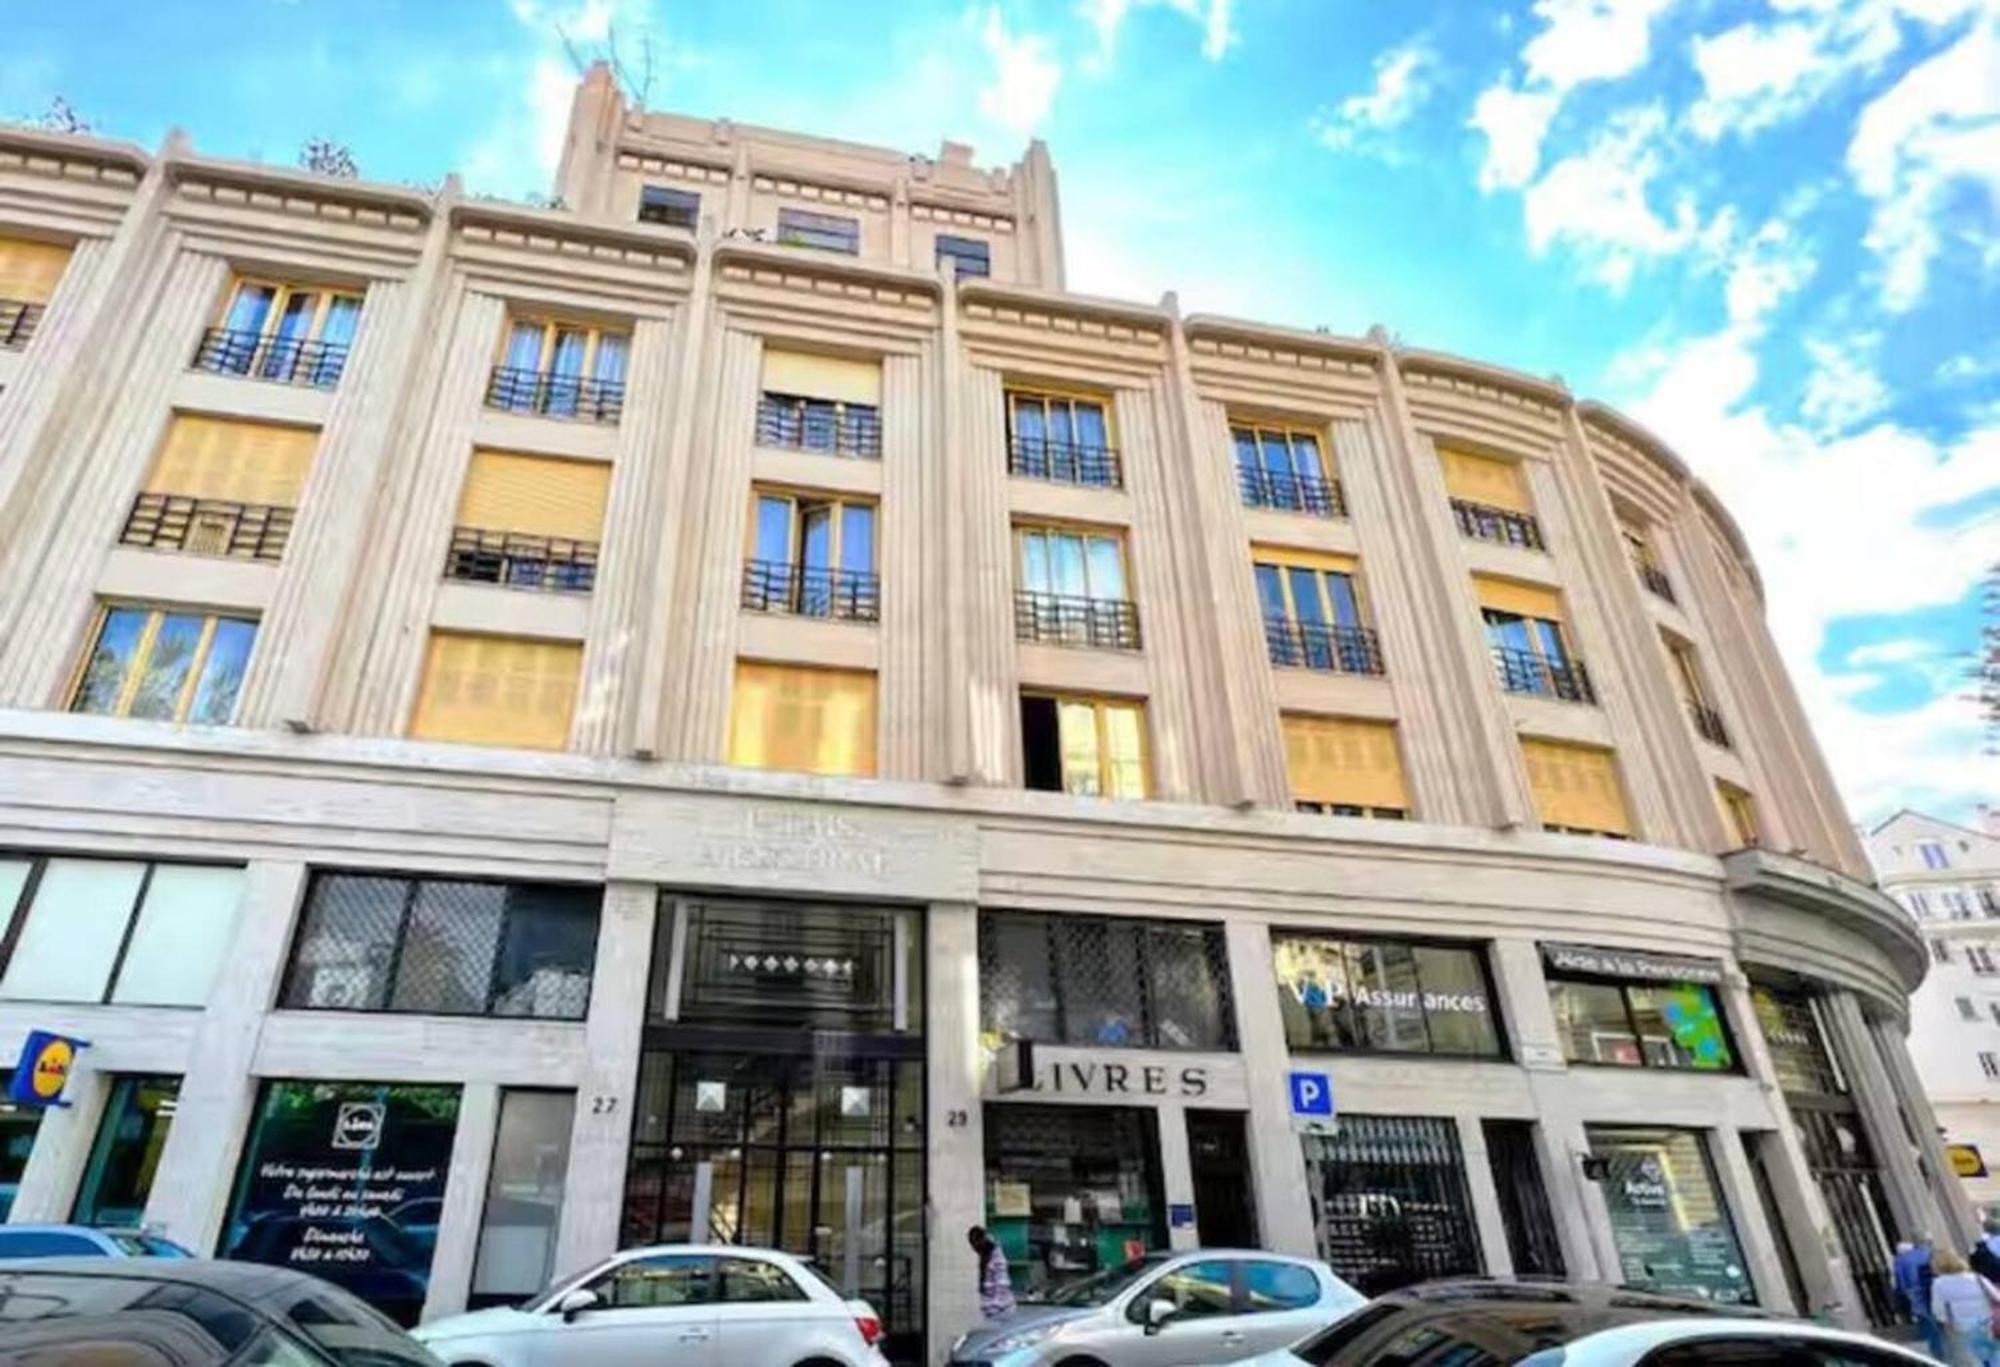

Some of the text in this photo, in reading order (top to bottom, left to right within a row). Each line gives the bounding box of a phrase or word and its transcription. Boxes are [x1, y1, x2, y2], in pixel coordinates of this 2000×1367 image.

[1016, 1039, 1207, 1096] LIVRES
[592, 1096, 618, 1115] 27
[1300, 1079, 1320, 1108] P
[947, 1109, 968, 1128] 29
